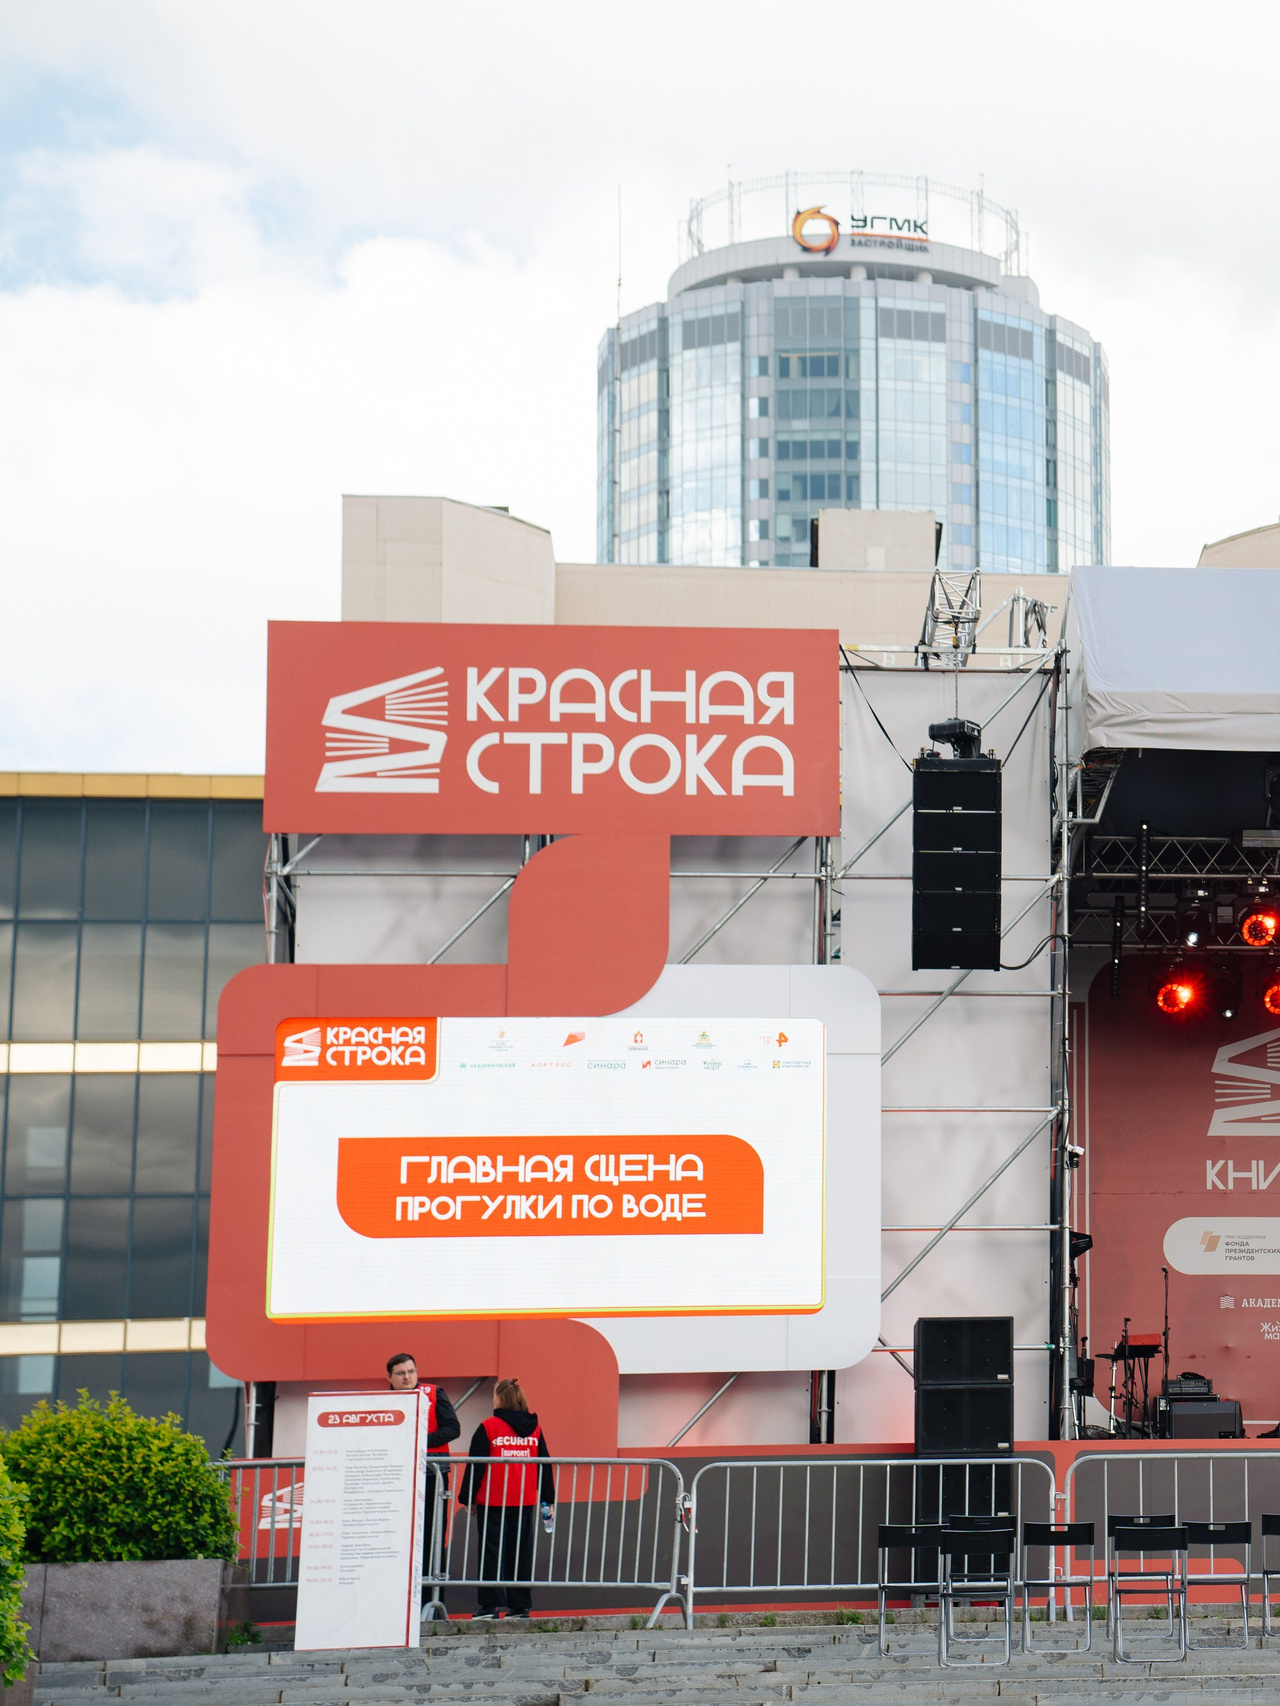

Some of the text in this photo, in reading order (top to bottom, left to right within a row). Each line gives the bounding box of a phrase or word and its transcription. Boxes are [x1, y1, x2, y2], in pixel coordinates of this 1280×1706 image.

[850, 214, 929, 235] УГМК
[850, 239, 930, 254] ЗАСТРОЙЩИК
[465, 666, 795, 726] КРАСНАЯ
[465, 730, 795, 797] СТРОКА
[325, 1025, 426, 1047] КРАСНАЯ
[325, 1046, 426, 1067] СТРОКА
[587, 1061, 626, 1071] синара
[399, 1153, 705, 1187] ГЛАВНАЯ СЦЕНА
[395, 1193, 707, 1222] ПРОГУЛКИ ПО ВОДЕ
[328, 1412, 395, 1424] 23 АВГУСТА
[492, 1435, 539, 1447] SECURITY
[503, 1449, 529, 1457] SUPPORT
